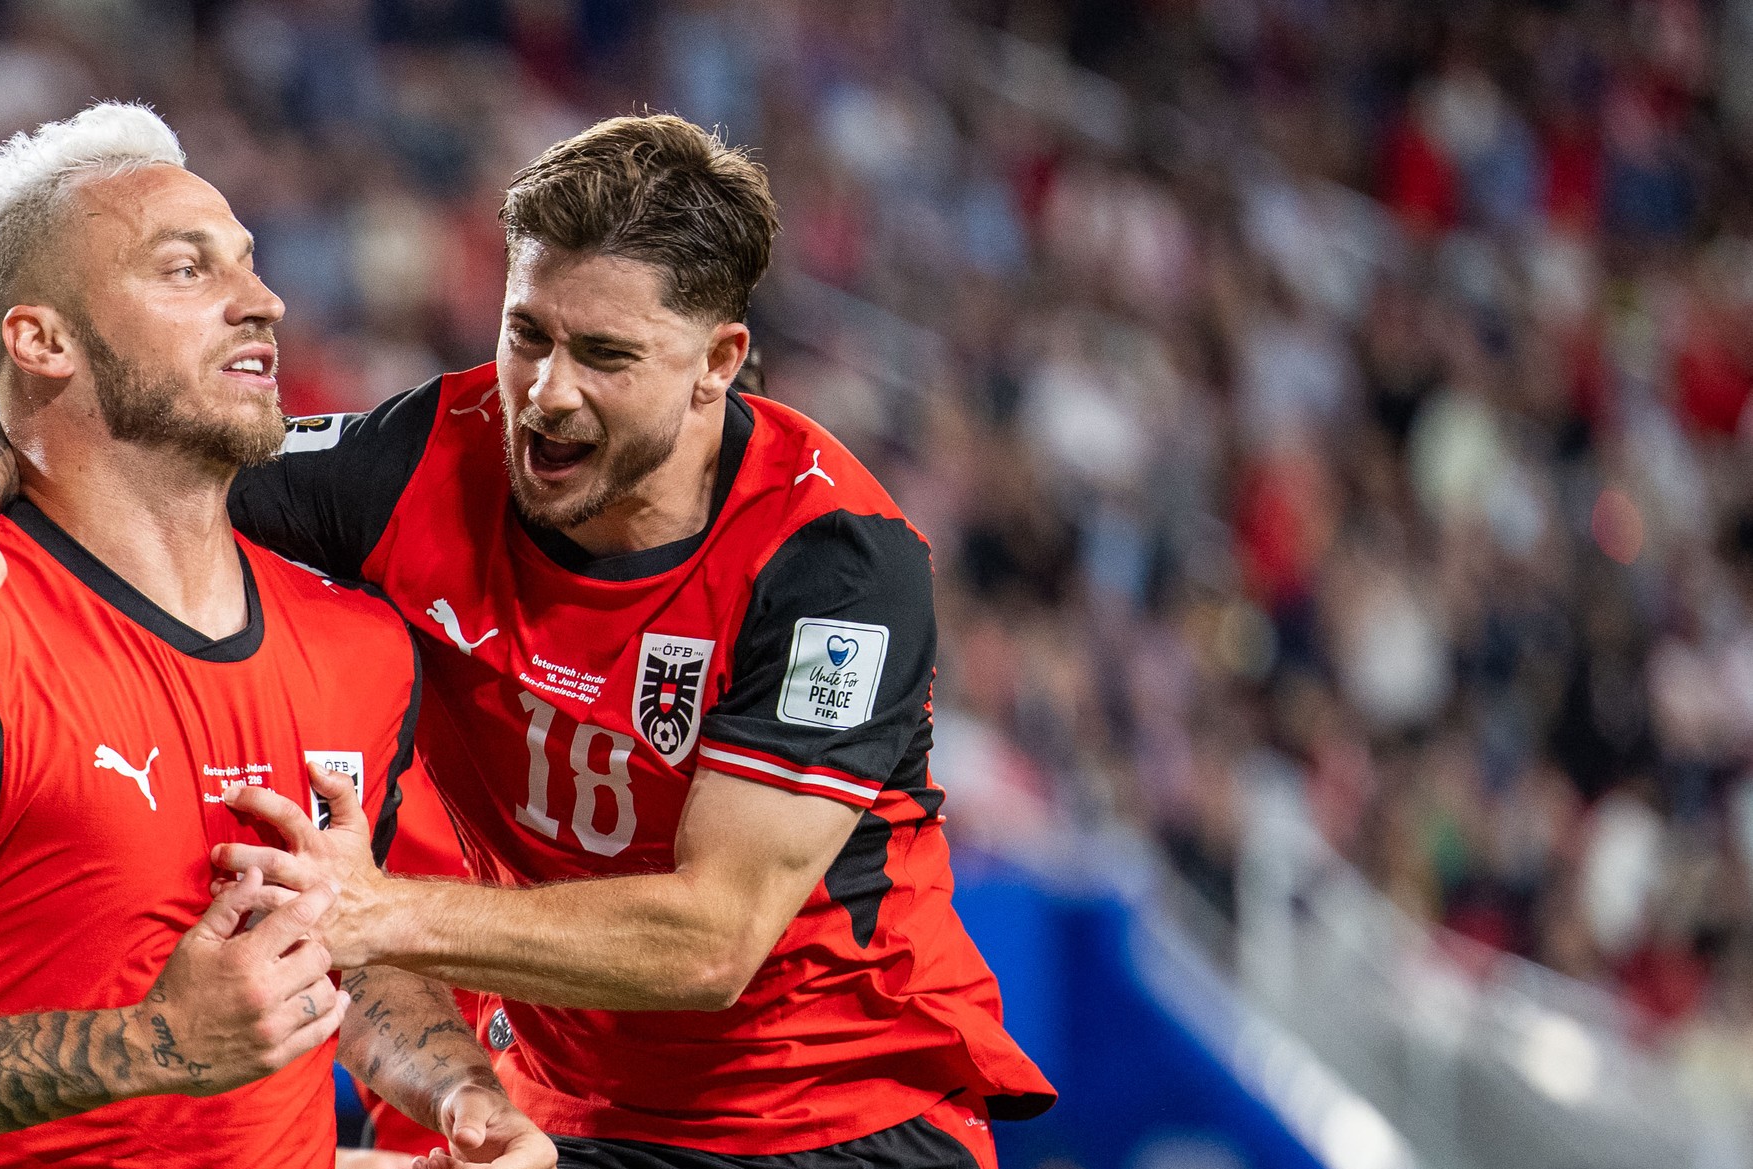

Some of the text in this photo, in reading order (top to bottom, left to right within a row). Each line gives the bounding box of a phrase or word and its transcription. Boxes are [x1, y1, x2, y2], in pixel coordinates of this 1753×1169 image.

[662, 643, 693, 658] ÖFB
[532, 654, 577, 678] Österreich
[581, 672, 607, 684] Jorda
[809, 666, 859, 689] Unite For
[558, 677, 579, 690] Juni
[808, 685, 853, 709] PEACE
[814, 707, 839, 720] FIFA
[325, 759, 349, 772] ÖFB
[515, 690, 638, 858] 18
